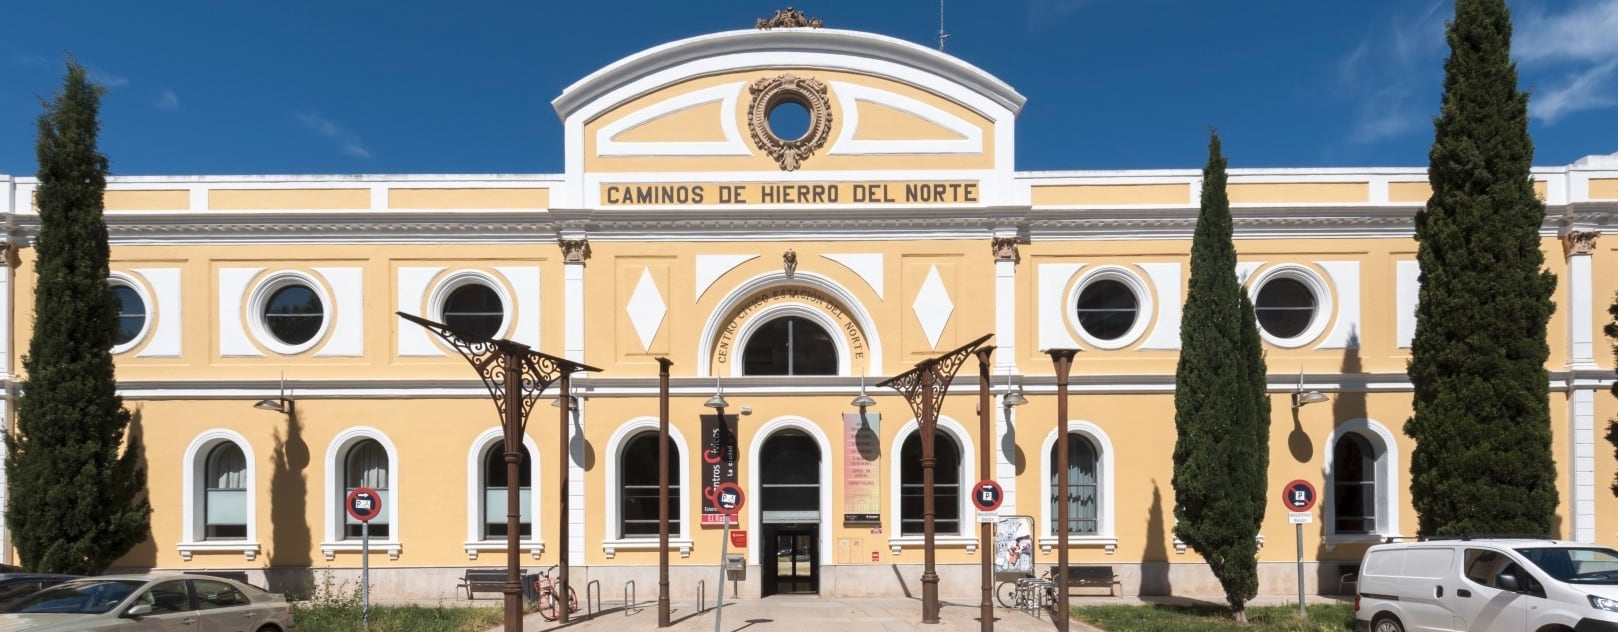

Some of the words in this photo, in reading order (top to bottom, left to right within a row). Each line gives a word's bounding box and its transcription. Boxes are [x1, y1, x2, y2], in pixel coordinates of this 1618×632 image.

[607, 186, 704, 204] CAMINOS
[719, 185, 747, 204] DE
[761, 184, 839, 204] HIERRO
[853, 184, 896, 203] DEL
[905, 183, 977, 203] NORTE
[718, 321, 738, 364] CENTRO
[773, 290, 825, 305] ESTACIÓN
[824, 300, 844, 320] DEL
[844, 321, 864, 360] NORTE
[727, 469, 733, 477] La
